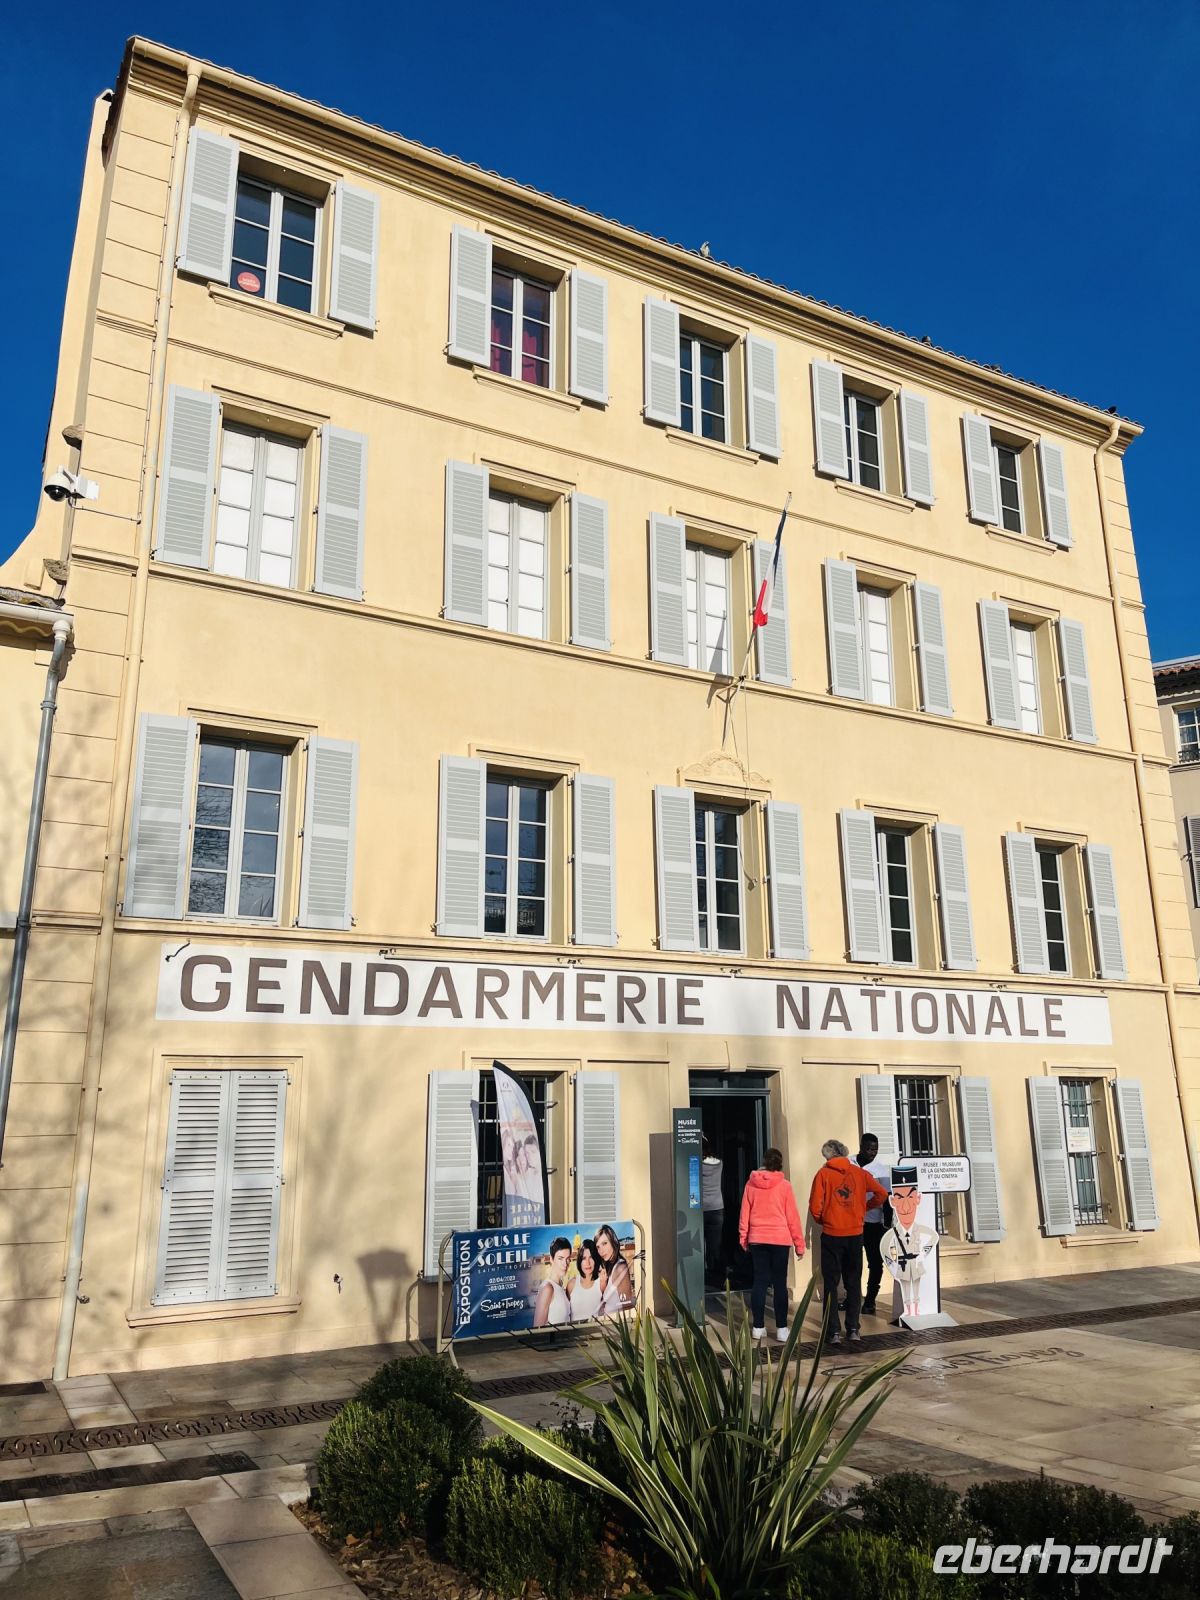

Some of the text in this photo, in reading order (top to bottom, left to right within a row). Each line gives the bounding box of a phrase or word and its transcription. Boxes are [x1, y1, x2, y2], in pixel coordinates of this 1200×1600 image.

[180, 955, 1066, 1038] GENDARMERIE NATIONALE
[477, 1233, 531, 1249] SOUS LE
[477, 1250, 529, 1267] SOLEIL
[460, 1240, 471, 1325] EXPOSITION
